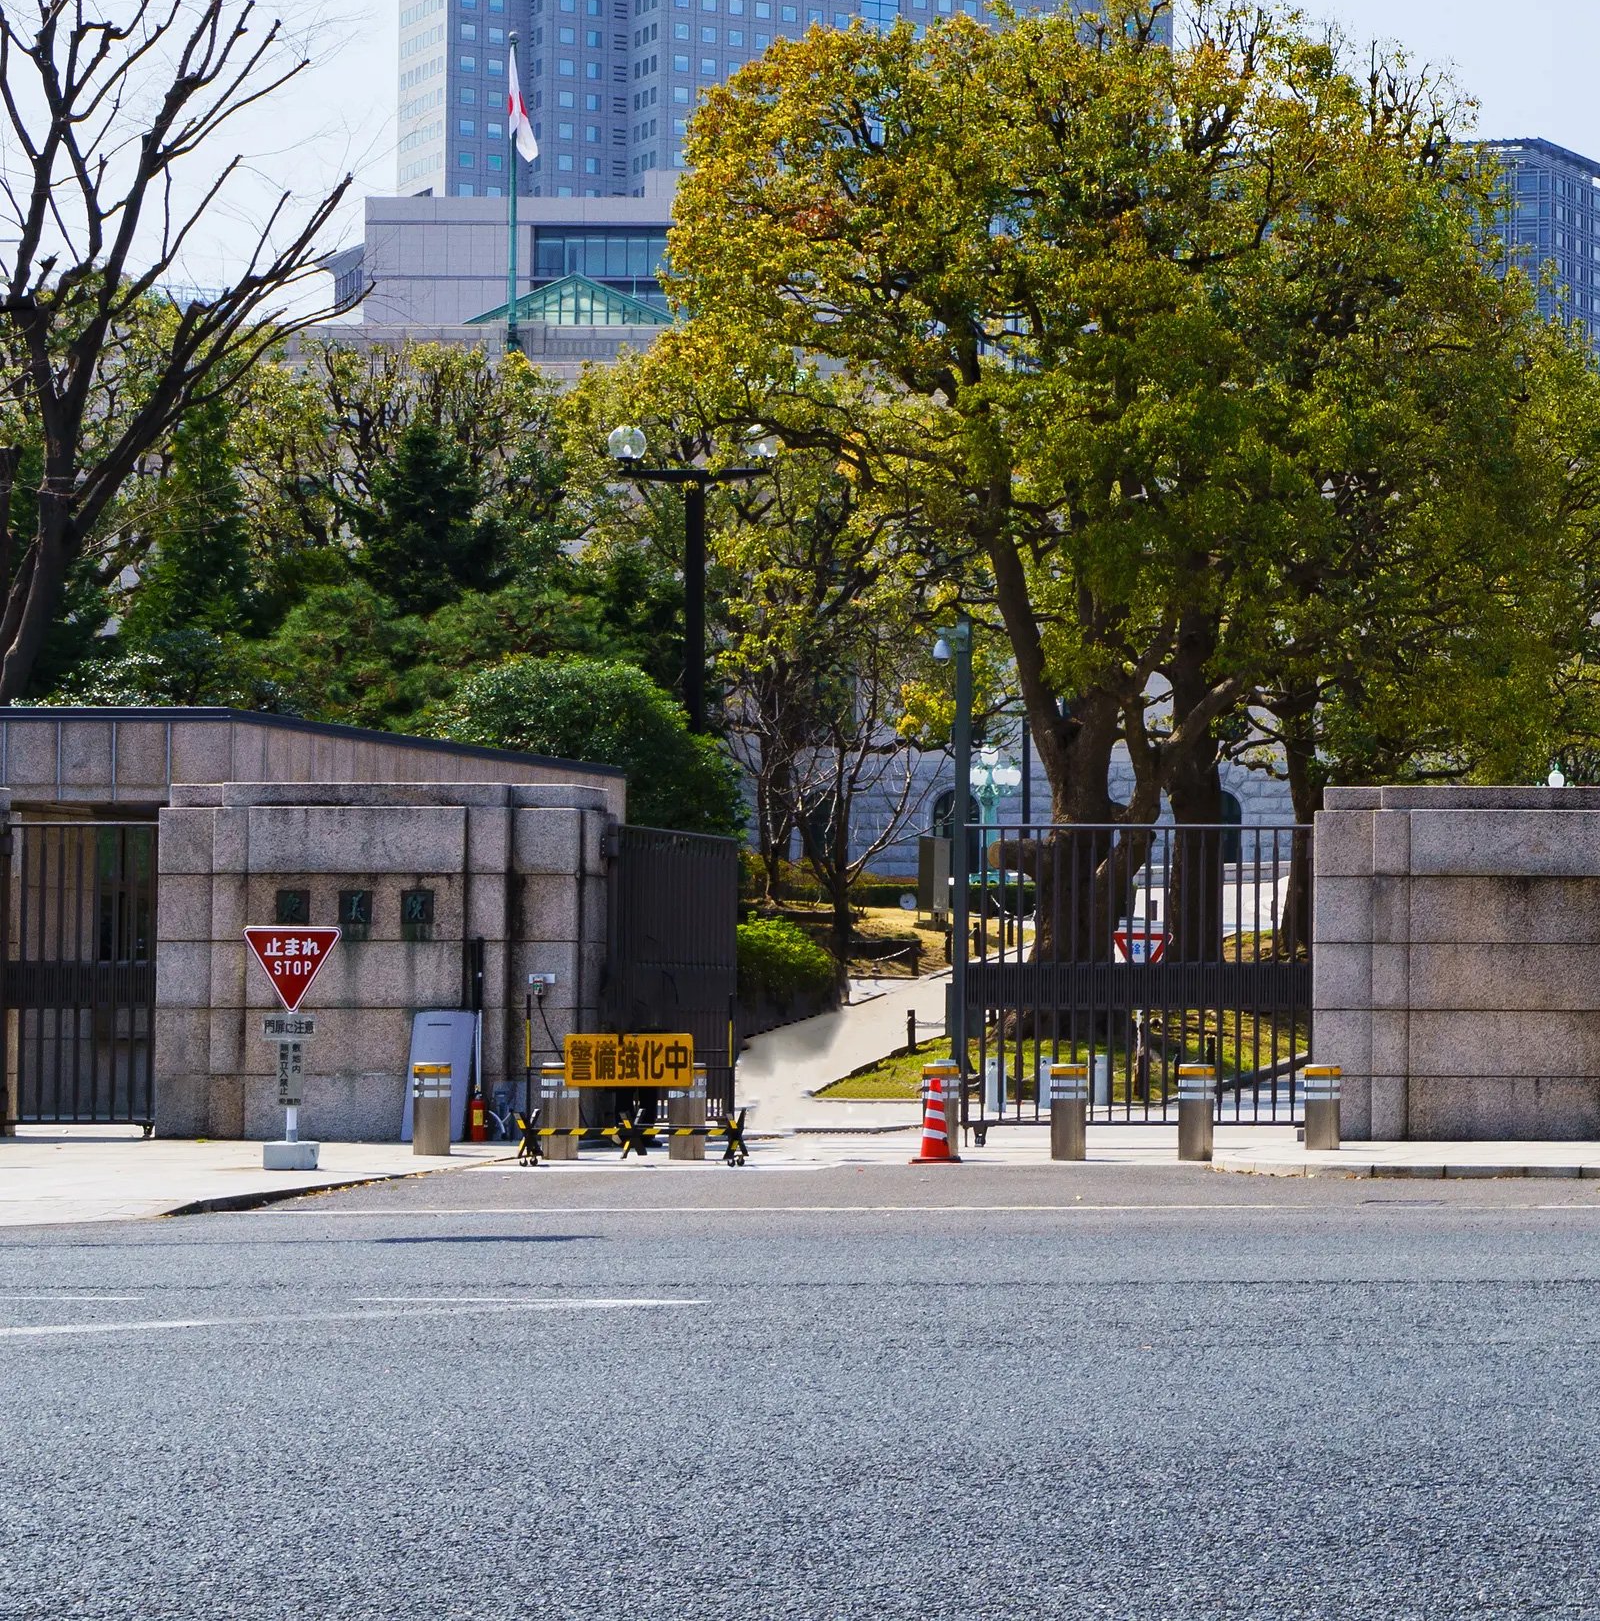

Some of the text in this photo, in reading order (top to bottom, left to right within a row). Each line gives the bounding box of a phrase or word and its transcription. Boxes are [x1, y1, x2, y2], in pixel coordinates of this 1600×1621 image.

[264, 937, 320, 956] 止まれ
[274, 961, 312, 975] STOP
[264, 1019, 314, 1035] 門扉に注意
[279, 1043, 289, 1096] 無断立入禁止
[292, 1043, 301, 1074] 敷地内
[570, 1040, 688, 1080] 警備強化中
